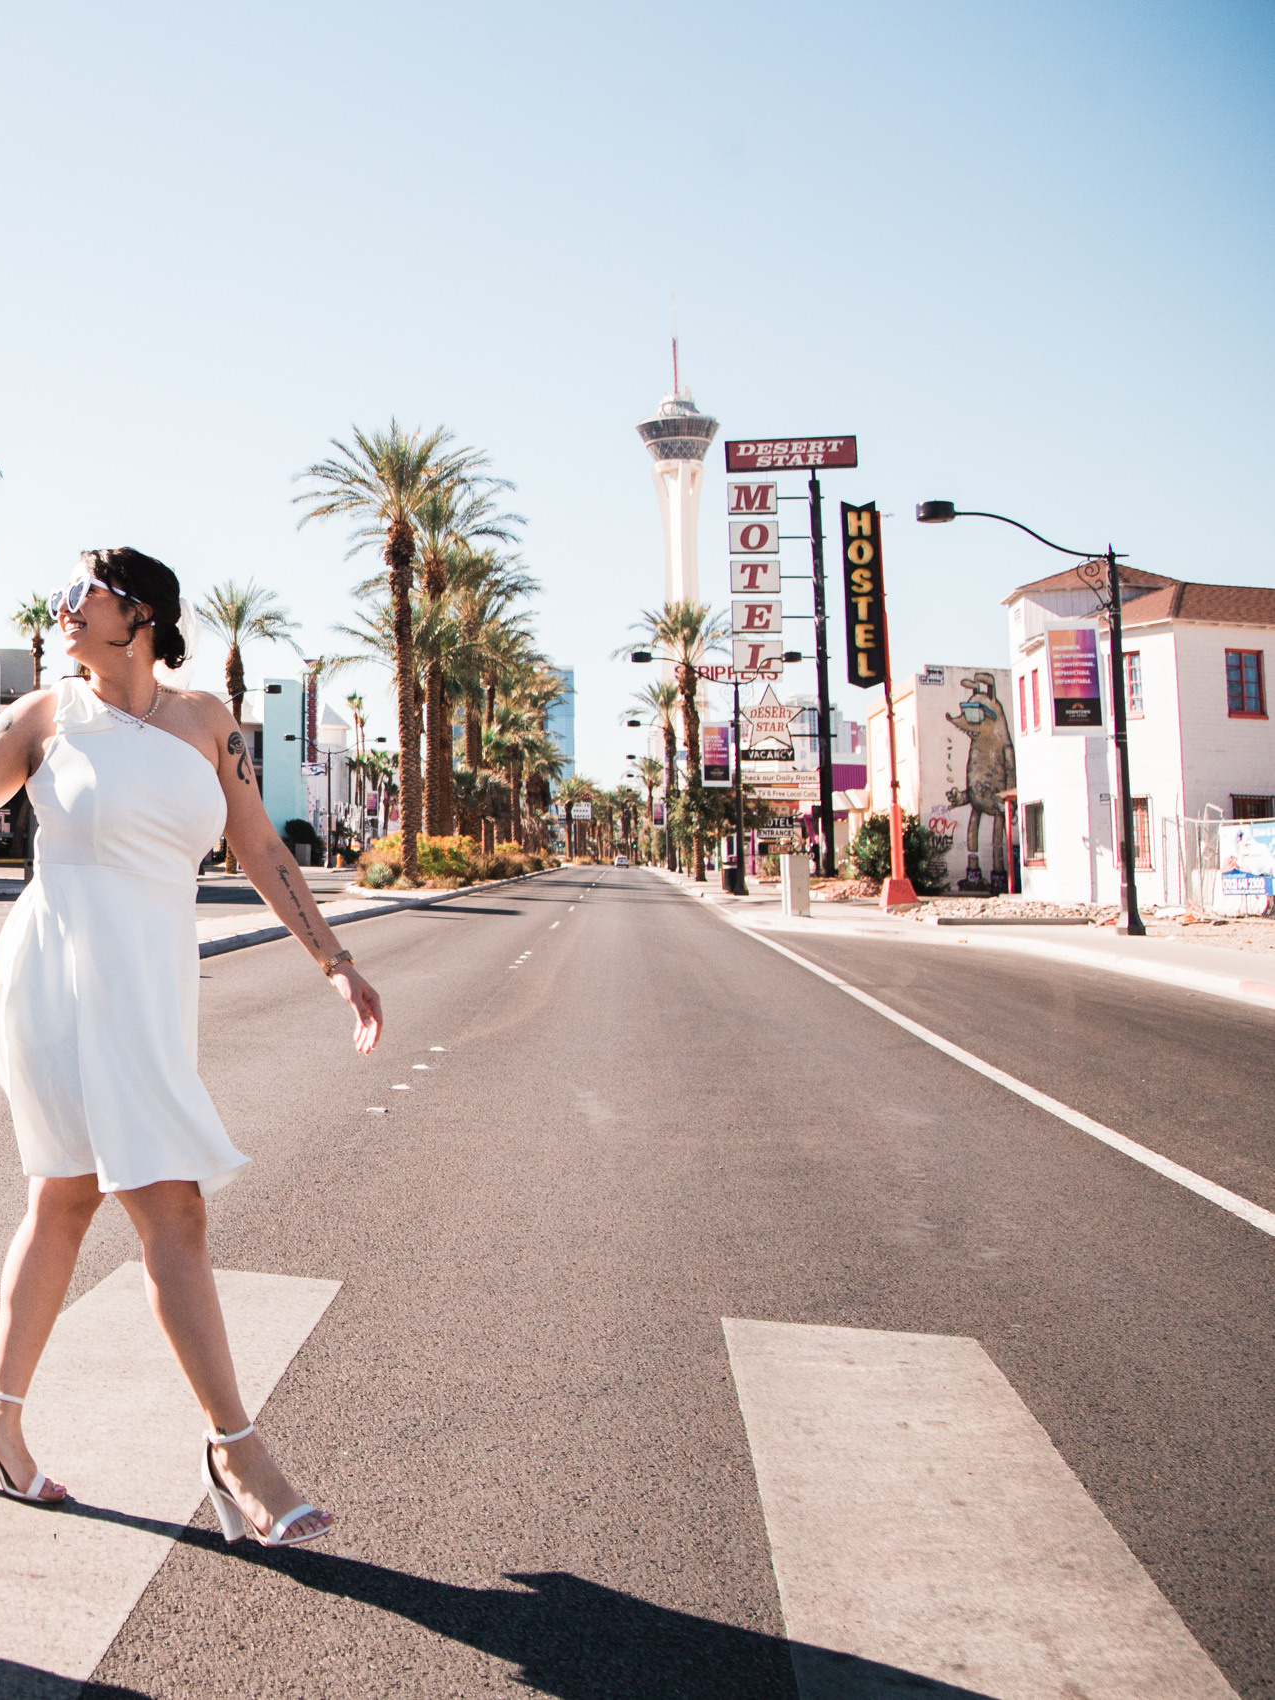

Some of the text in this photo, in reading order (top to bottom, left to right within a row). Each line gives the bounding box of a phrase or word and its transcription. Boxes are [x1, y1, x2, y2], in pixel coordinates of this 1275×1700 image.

[736, 440, 843, 456] DESERT
[756, 453, 825, 467] STAR
[731, 485, 774, 670] MOTEL
[847, 511, 876, 678] HOSTEL
[674, 665, 779, 681] SRIPPERS
[750, 706, 794, 719] DESERT
[755, 722, 786, 733] STAR
[748, 750, 794, 760] VACANCY
[776, 774, 794, 783] Daily
[803, 790, 818, 798] Calls
[764, 817, 792, 827] OTEL
[758, 829, 792, 837] ENTRANCE
